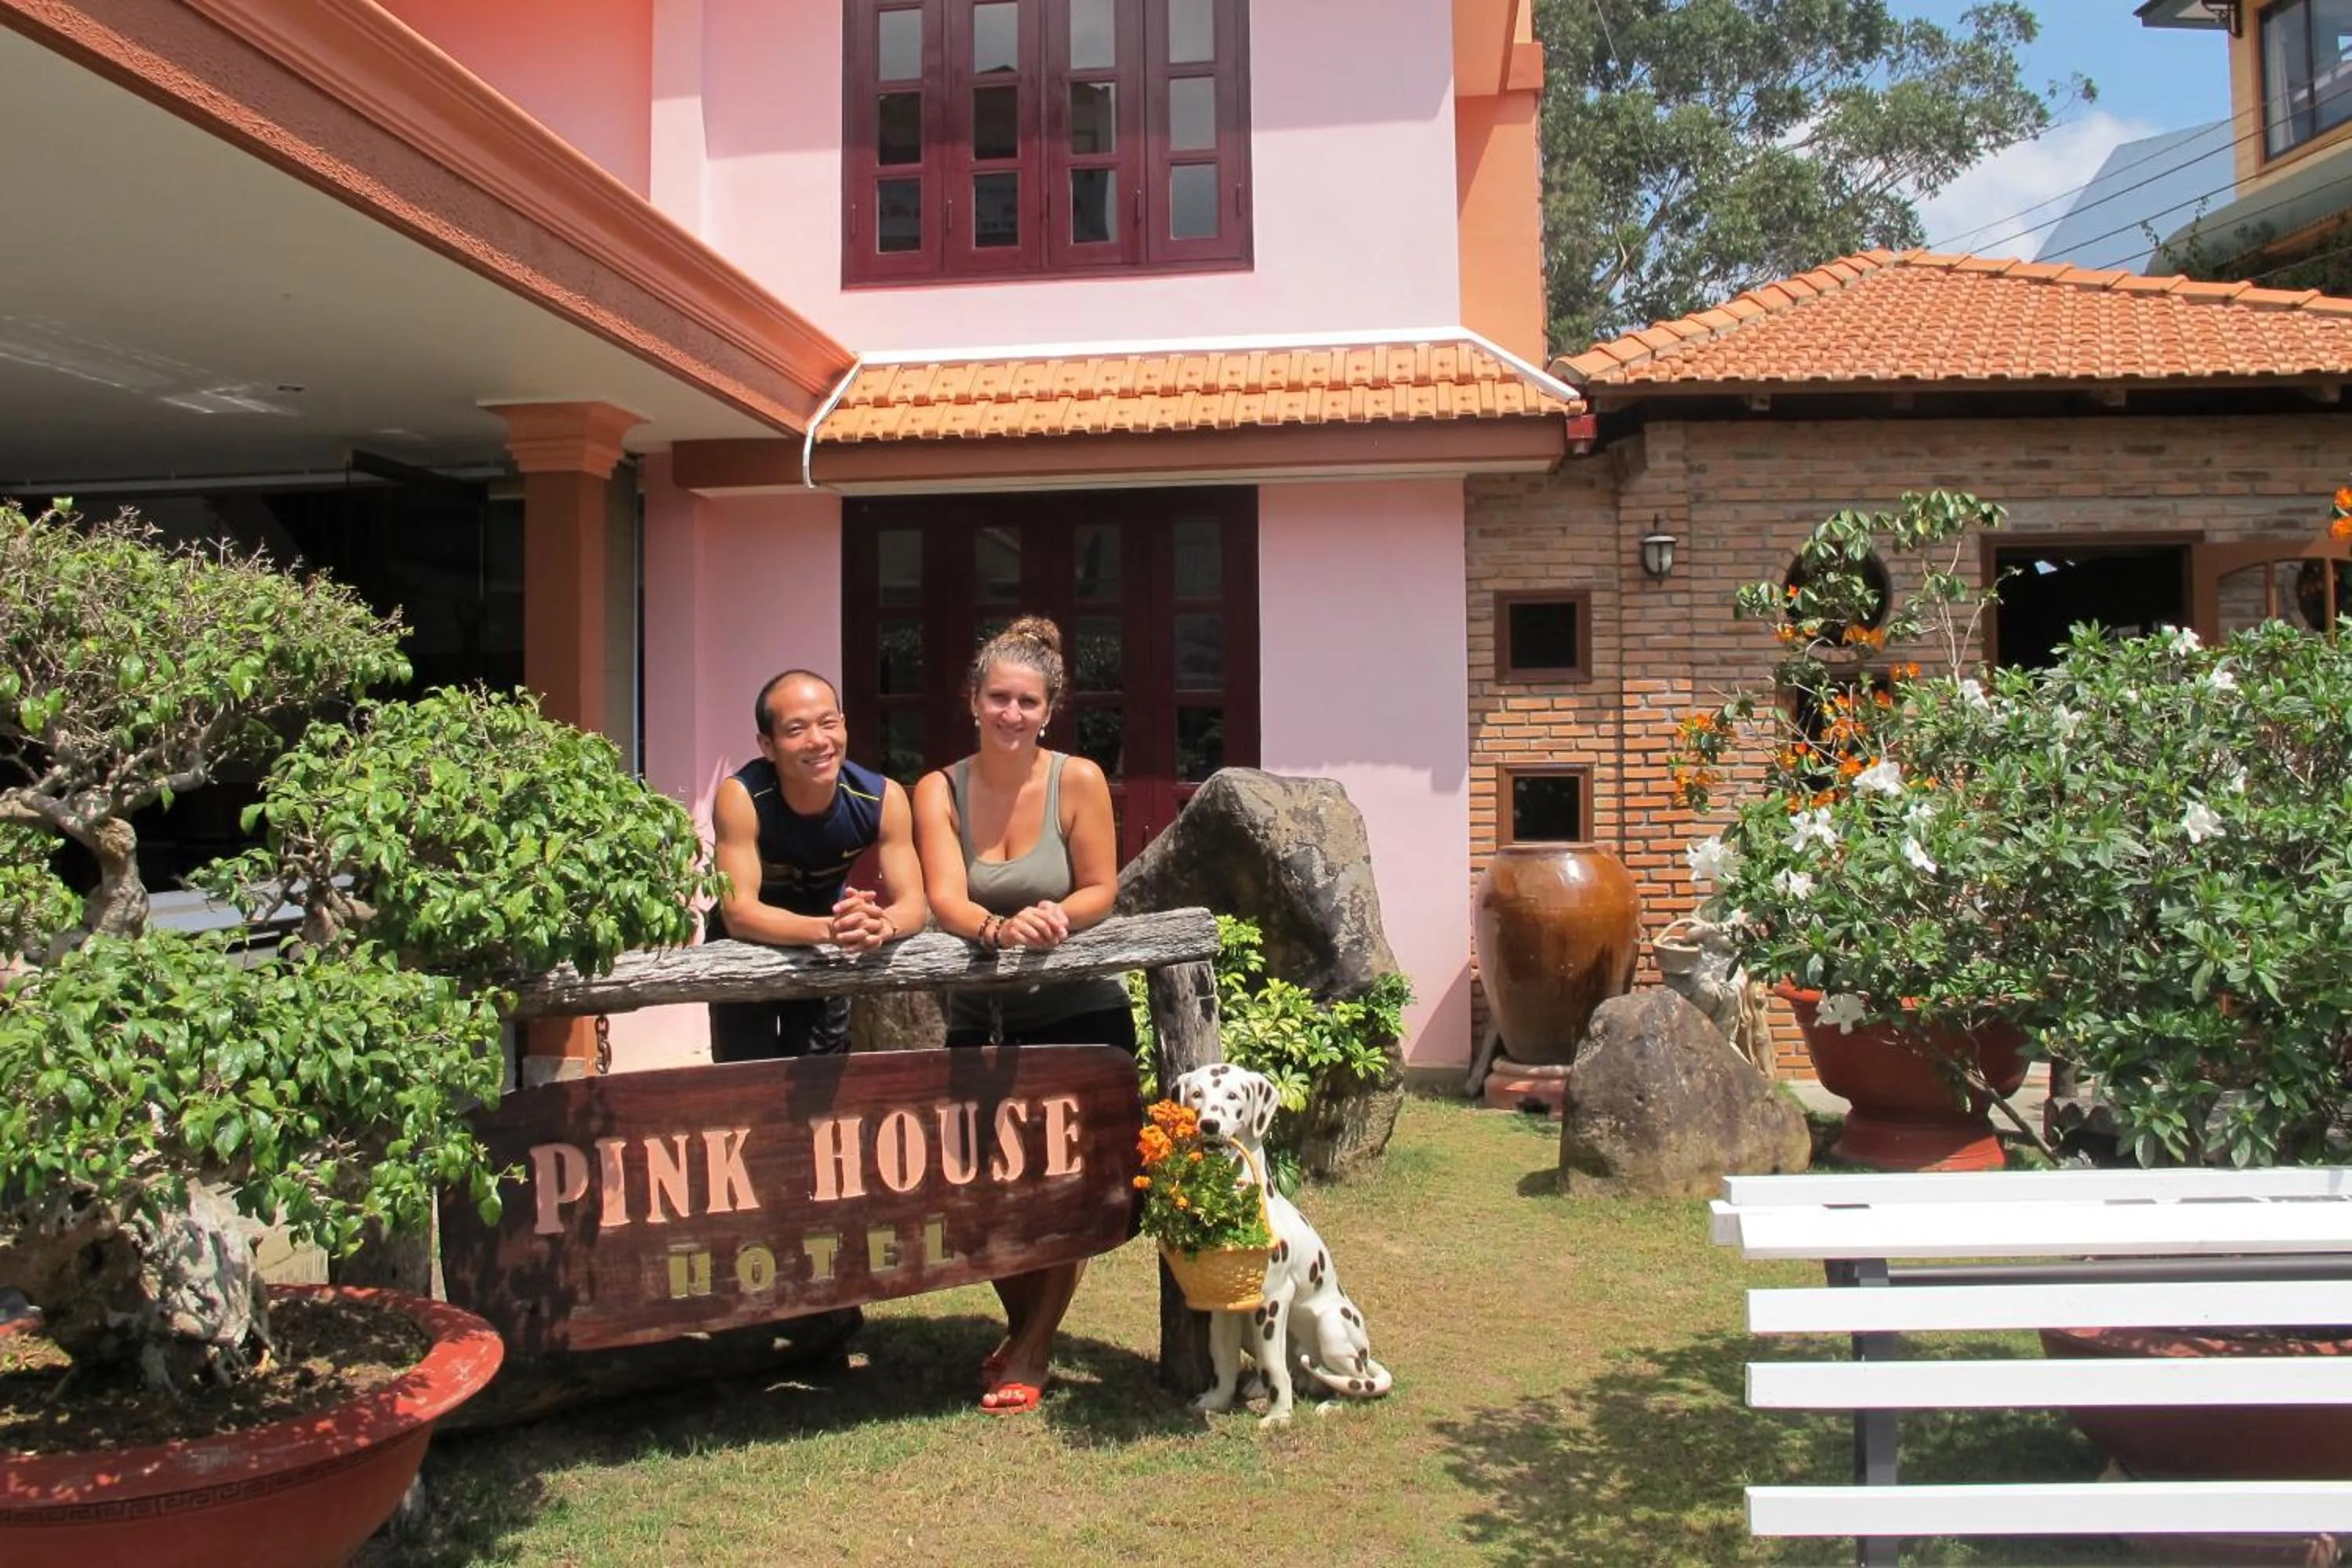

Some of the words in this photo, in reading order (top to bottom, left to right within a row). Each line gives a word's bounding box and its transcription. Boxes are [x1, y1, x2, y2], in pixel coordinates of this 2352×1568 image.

[530, 1128, 760, 1233] PINK
[808, 1098, 1083, 1201] HOUSE
[668, 1215, 955, 1299] HOTEL
